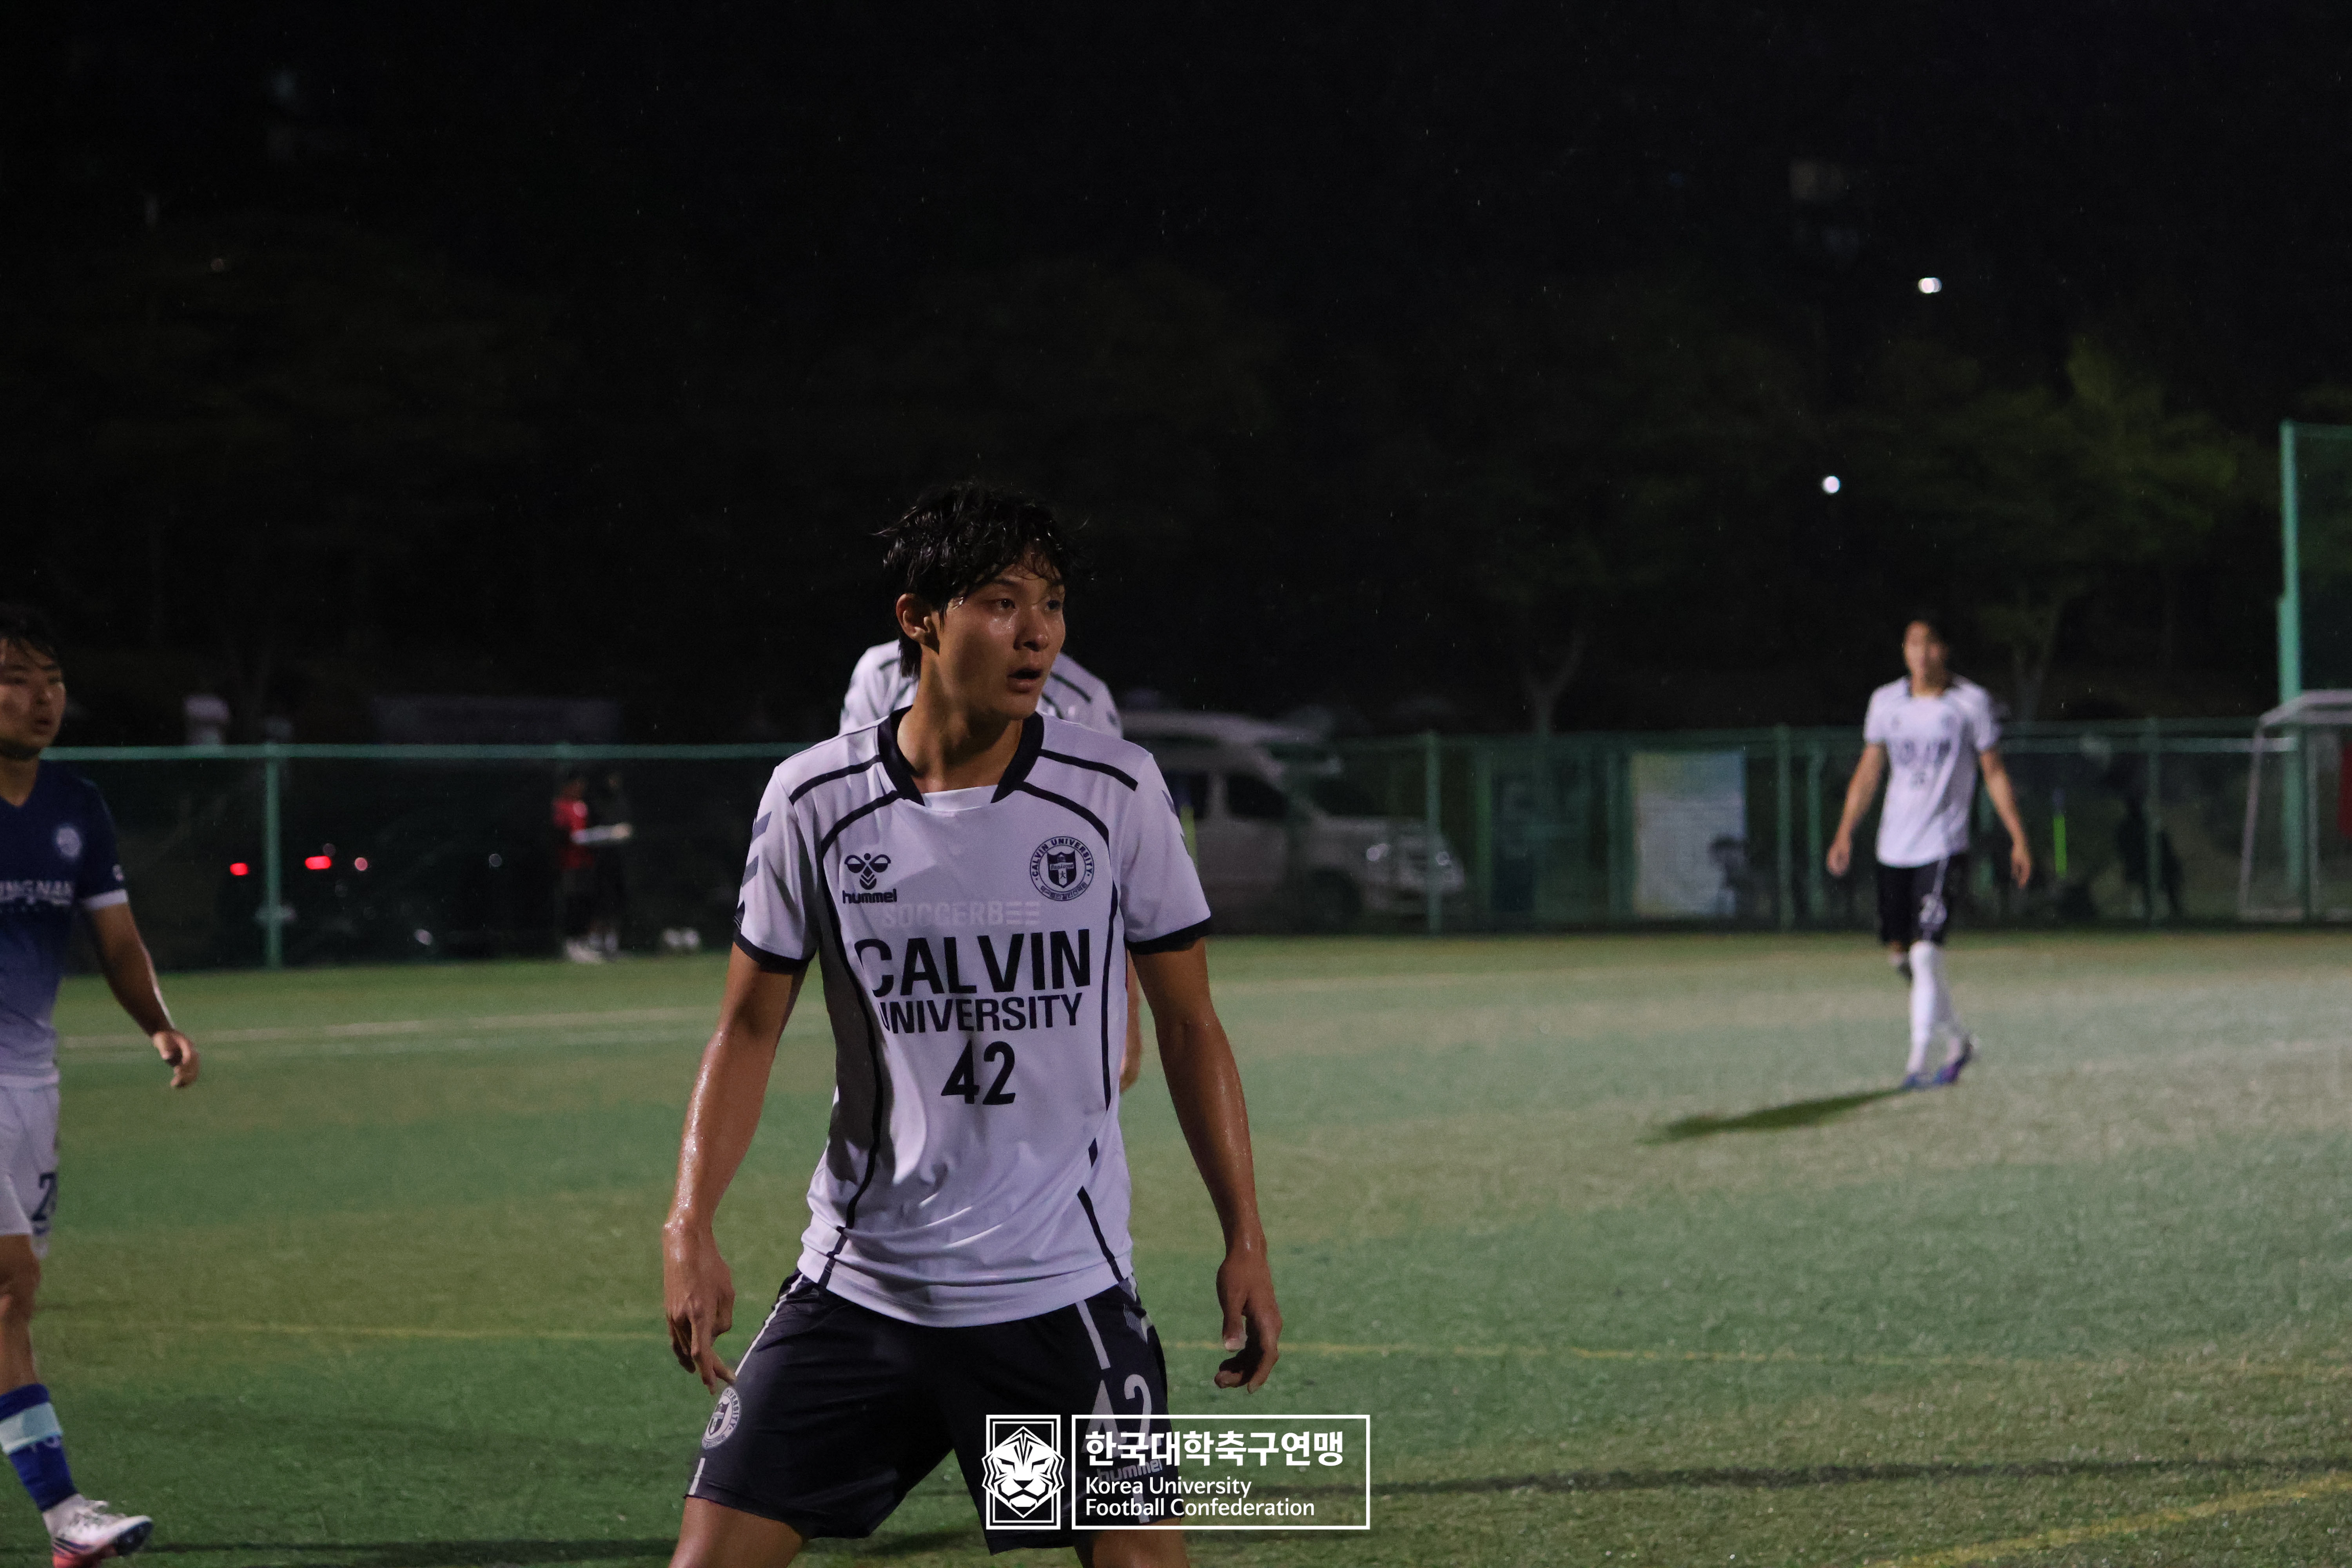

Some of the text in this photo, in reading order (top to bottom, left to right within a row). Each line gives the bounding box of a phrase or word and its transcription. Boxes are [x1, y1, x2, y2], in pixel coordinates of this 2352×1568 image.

[1032, 838, 1093, 877] CALVIN UNIVERSITY
[842, 889, 897, 904] hummel
[880, 900, 1041, 927] SOCCERBEE
[854, 929, 1090, 997] CALVIN
[878, 993, 1082, 1034] UNIVERSITY
[941, 1040, 1016, 1105] 42
[1081, 1374, 1162, 1460] 42
[1096, 1458, 1163, 1483] hummel
